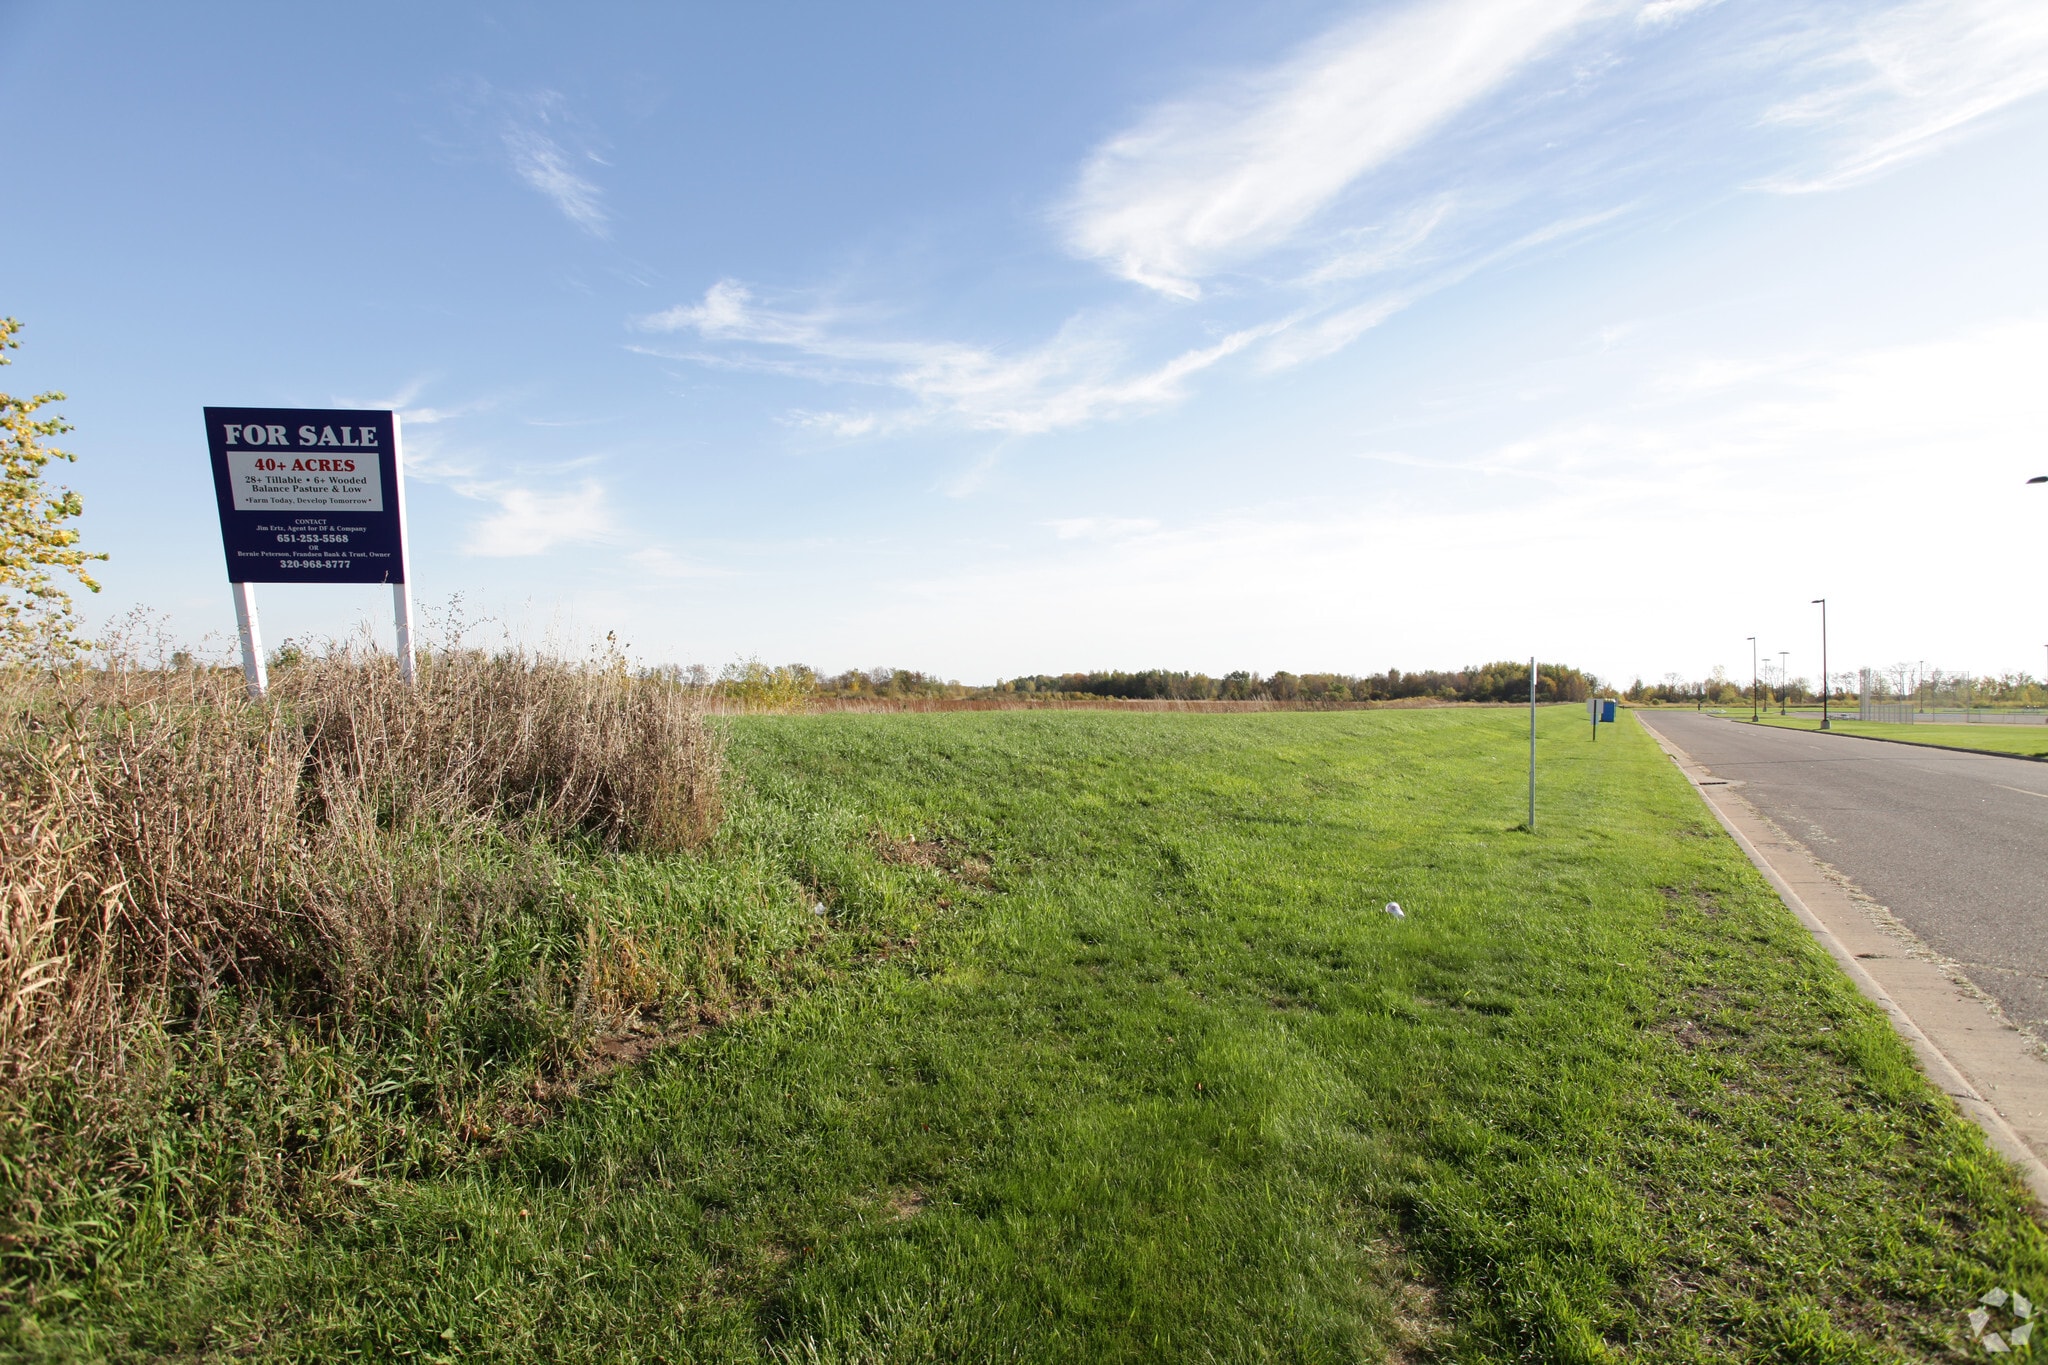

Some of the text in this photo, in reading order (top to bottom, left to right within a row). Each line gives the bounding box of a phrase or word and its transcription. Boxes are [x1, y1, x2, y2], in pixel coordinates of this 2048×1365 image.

[223, 424, 379, 447] FOR SALE
[254, 458, 356, 472] 40+ ACRES
[245, 475, 367, 485] 28+ Tillable 6+ Wooded
[252, 484, 362, 493] Balance Pasture & Low
[270, 497, 295, 505] Today,
[297, 497, 327, 505] Develop
[336, 525, 367, 533] Company
[276, 533, 349, 543] 651-253-5568
[280, 559, 351, 569] 320-968-8777
